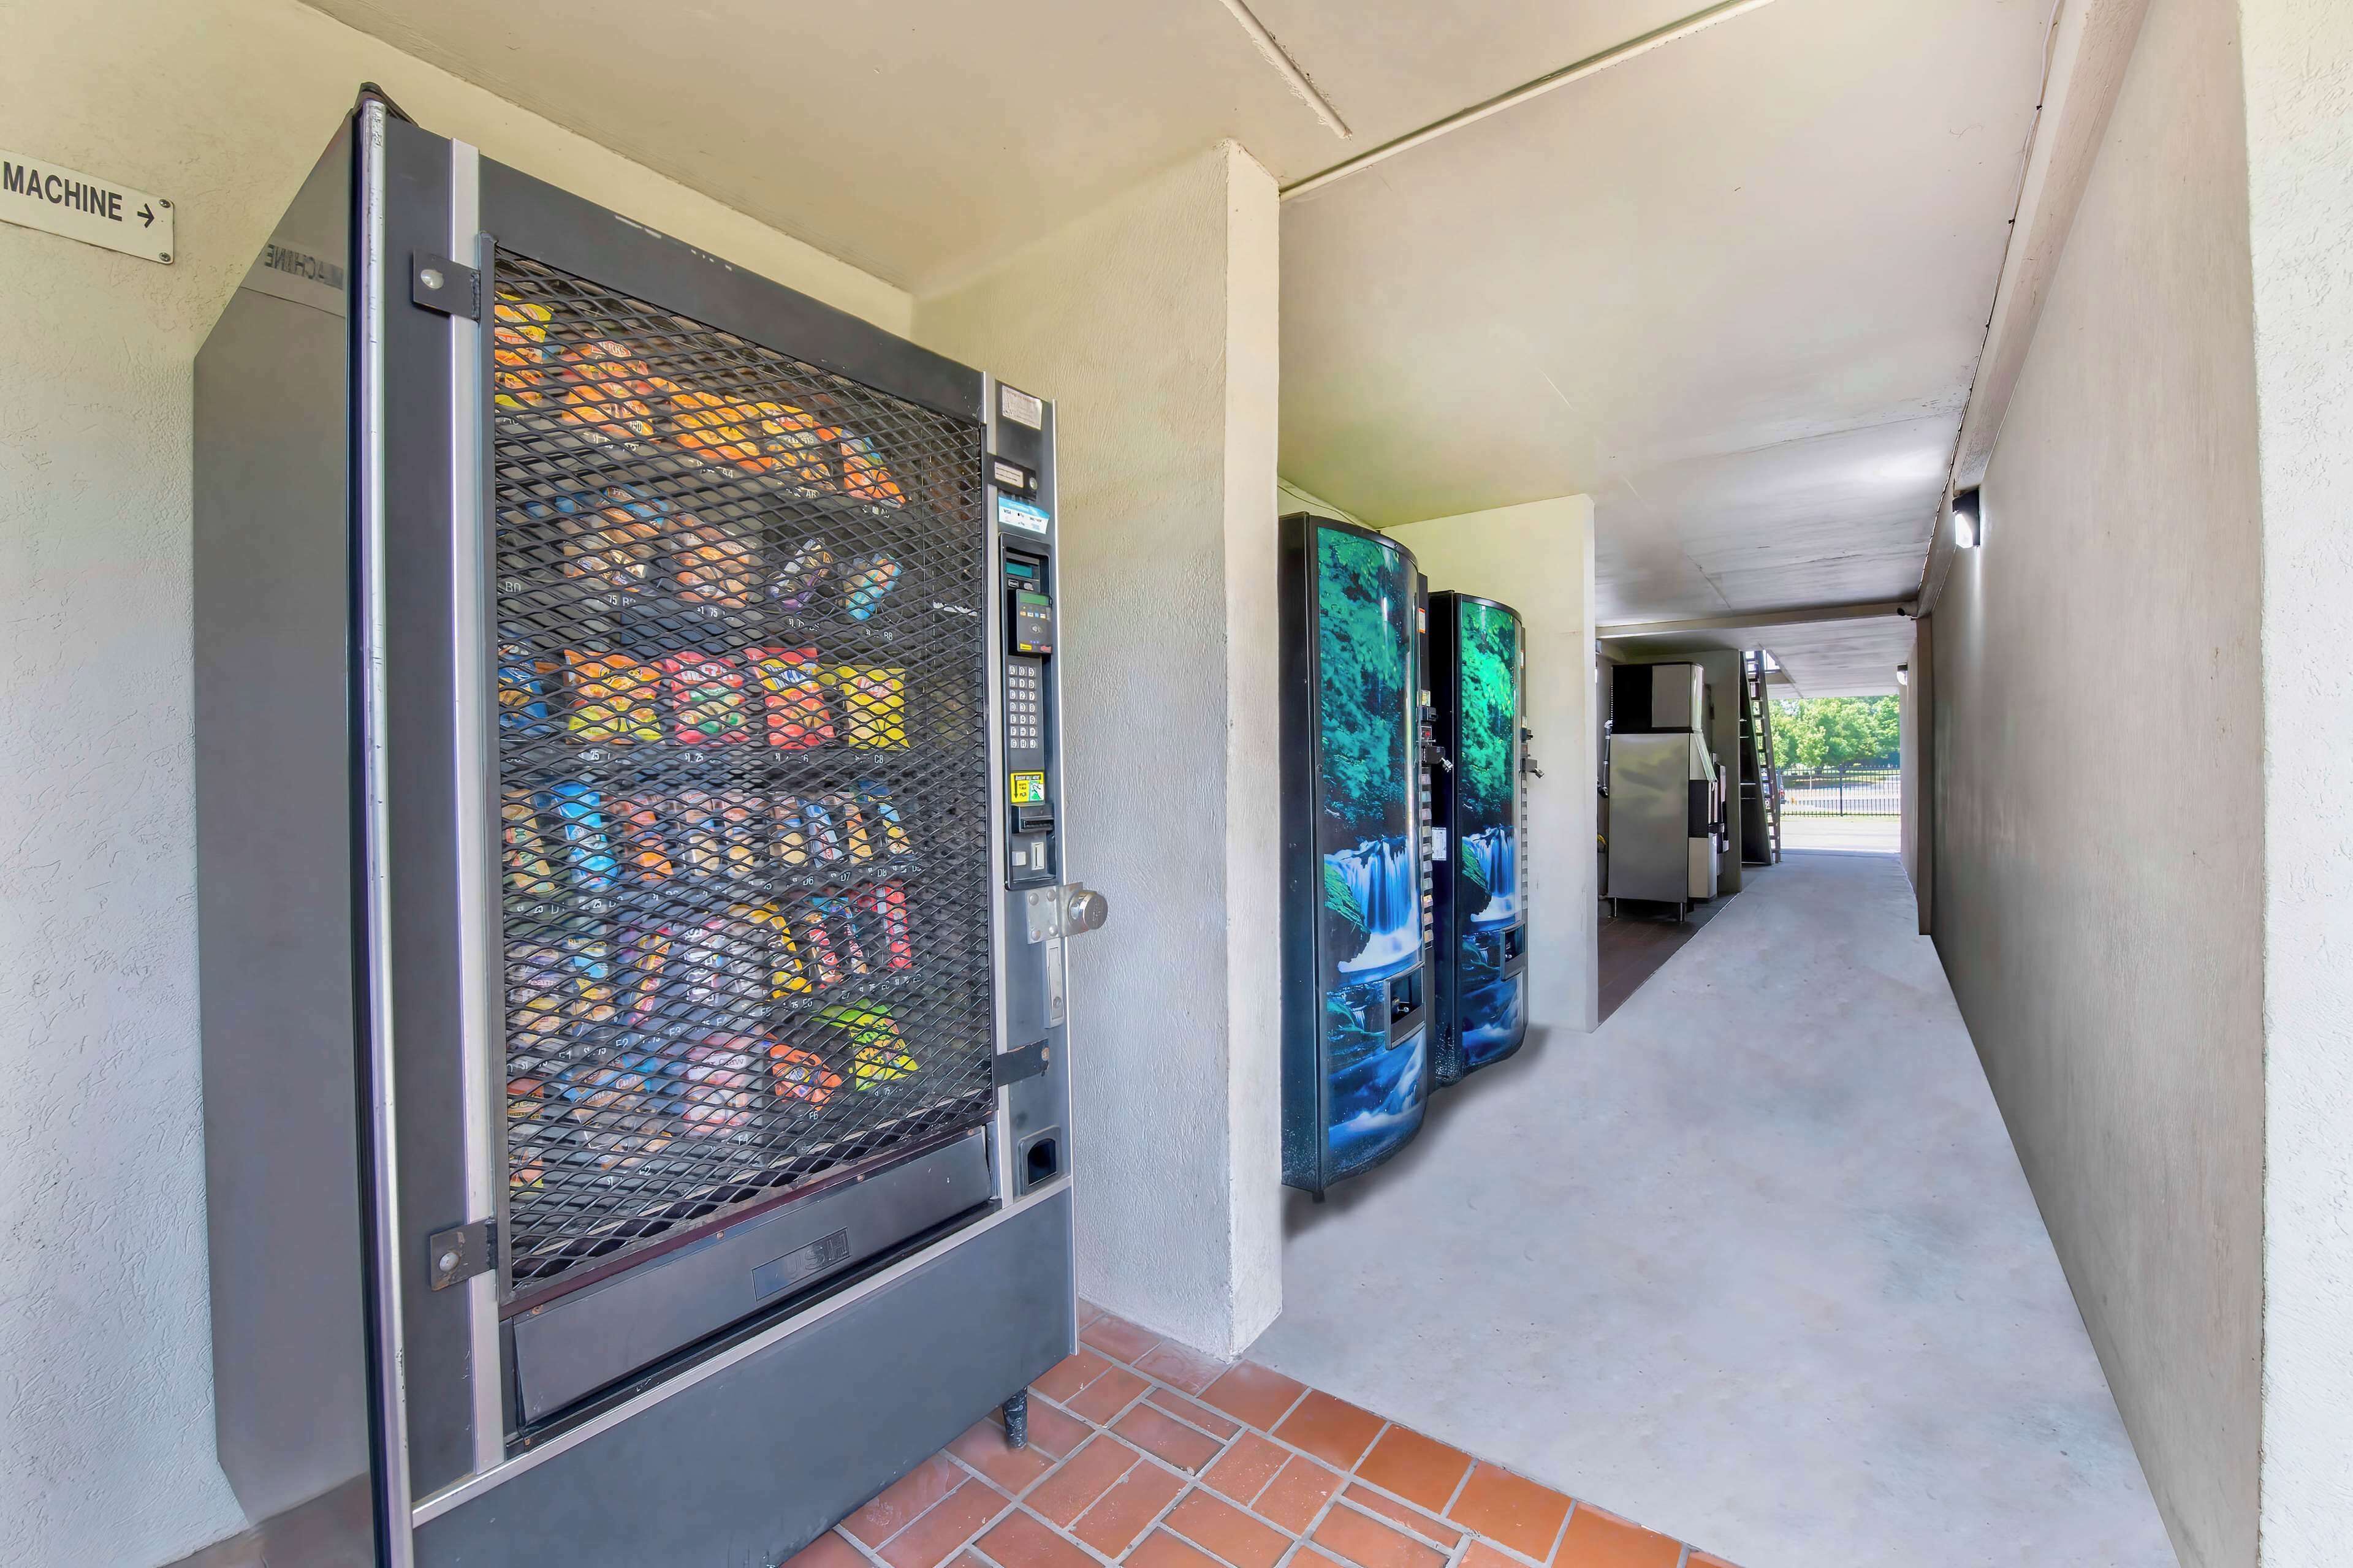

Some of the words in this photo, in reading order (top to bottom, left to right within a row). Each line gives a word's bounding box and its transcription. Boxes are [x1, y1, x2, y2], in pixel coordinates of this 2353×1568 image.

[4, 161, 123, 222] MACHINE
[719, 1058, 744, 1066] Caw
[782, 1230, 848, 1281] USH
